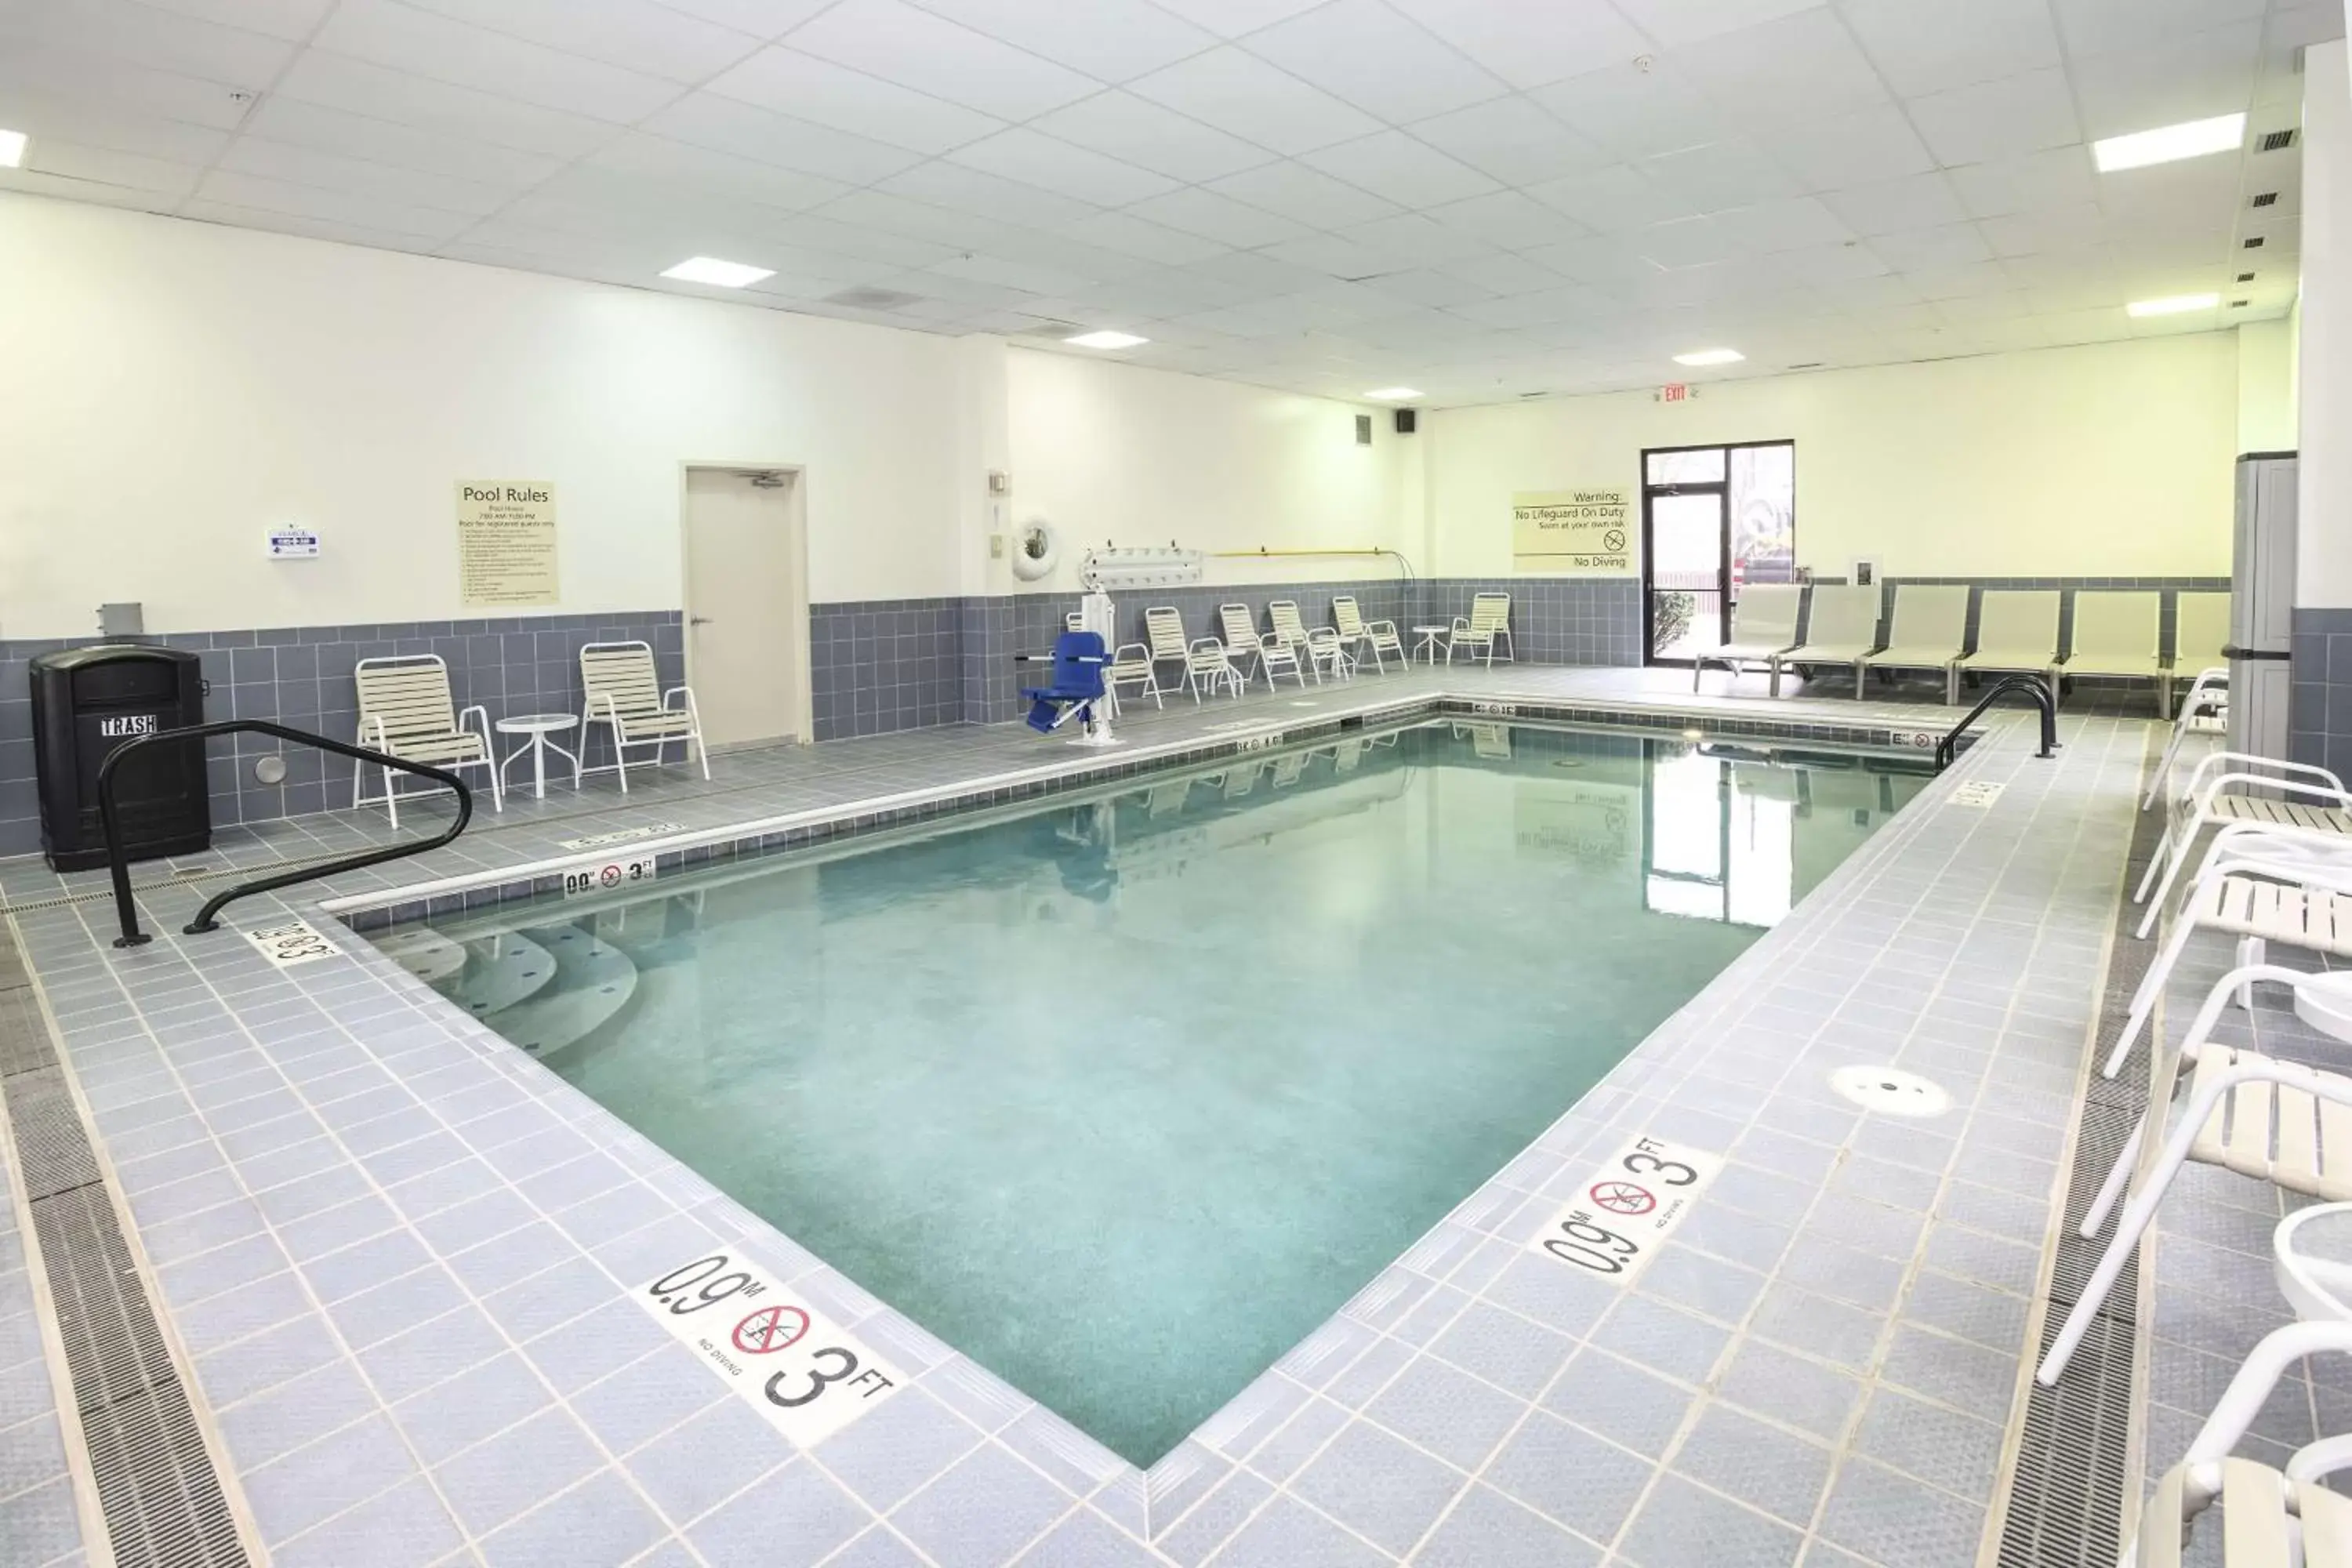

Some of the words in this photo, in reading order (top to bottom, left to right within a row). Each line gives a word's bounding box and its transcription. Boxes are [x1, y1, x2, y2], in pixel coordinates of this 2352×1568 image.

[1666, 385, 1685, 401] EXIT
[463, 486, 500, 501] Pool
[506, 488, 549, 503] Rules
[1515, 510, 1530, 520] No
[1533, 508, 1578, 521] Lifeguard
[1581, 507, 1597, 517] On
[1600, 506, 1625, 517] Duty
[1574, 557, 1590, 567] No
[1592, 555, 1626, 569] Diving
[103, 716, 154, 735] TRASH
[698, 1338, 713, 1351] NO
[710, 1349, 744, 1376] DIVING
